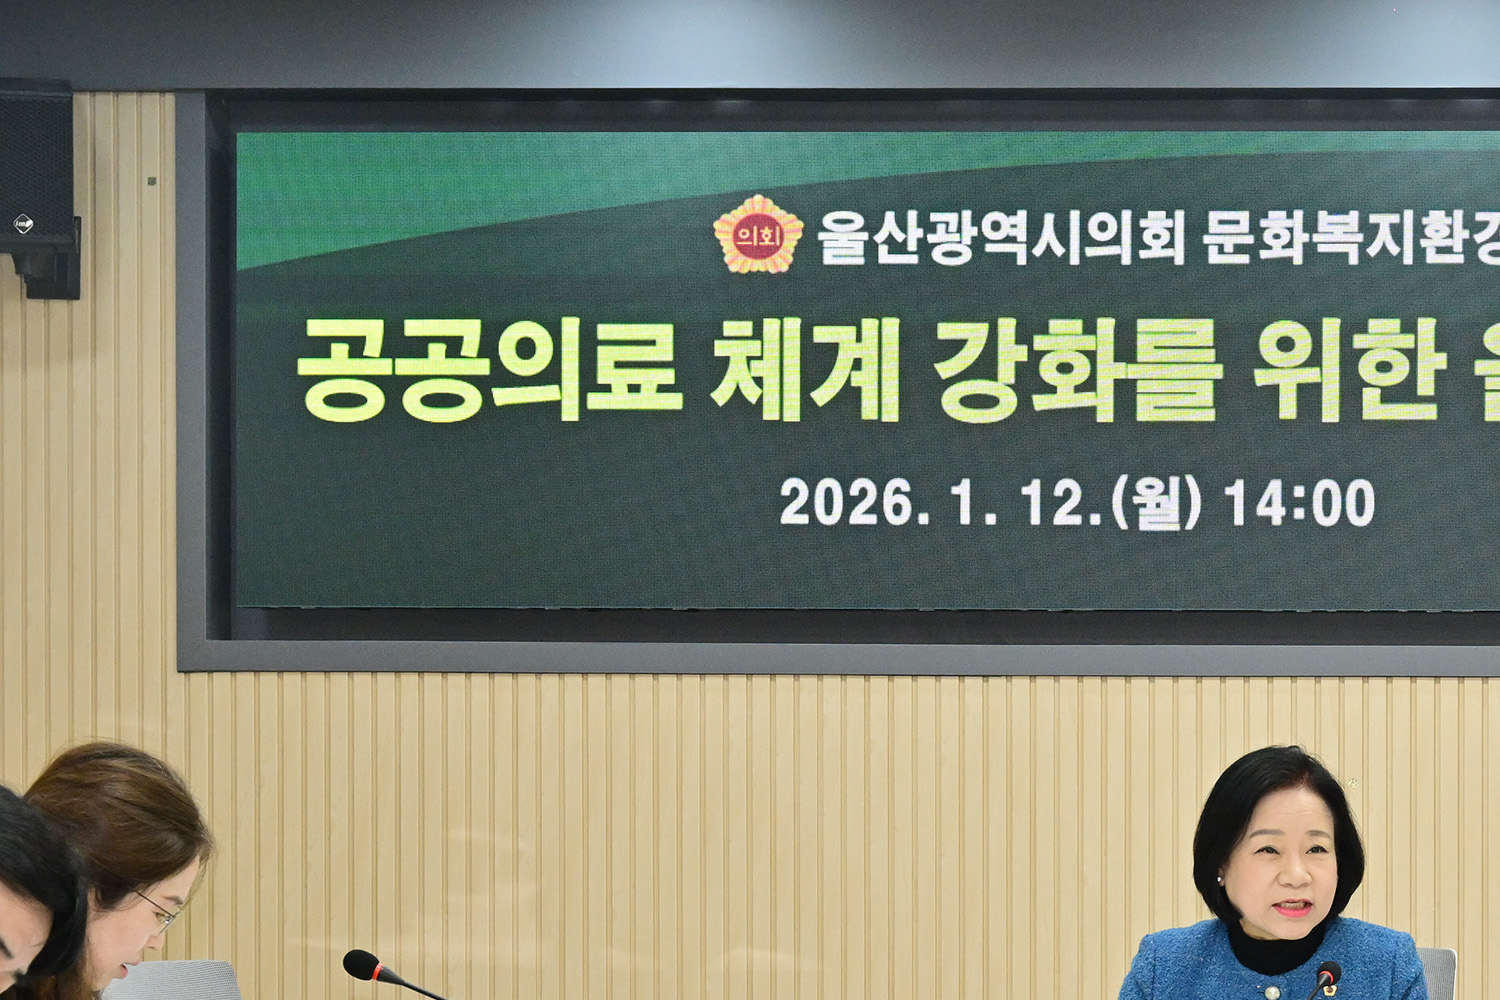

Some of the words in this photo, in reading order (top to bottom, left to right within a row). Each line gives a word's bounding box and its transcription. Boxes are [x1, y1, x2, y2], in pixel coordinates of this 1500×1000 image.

[736, 225, 780, 246] 의회
[818, 209, 1185, 267] 울산광역시의회
[297, 317, 684, 423] 공공의료
[711, 317, 900, 423] 체계
[933, 317, 1224, 424] 강화를
[1253, 317, 1448, 423] 위한
[780, 477, 929, 526] 2026.
[950, 478, 997, 526] 1.
[1021, 473, 1202, 532] 12.(월)
[1224, 478, 1375, 527] 14:00
